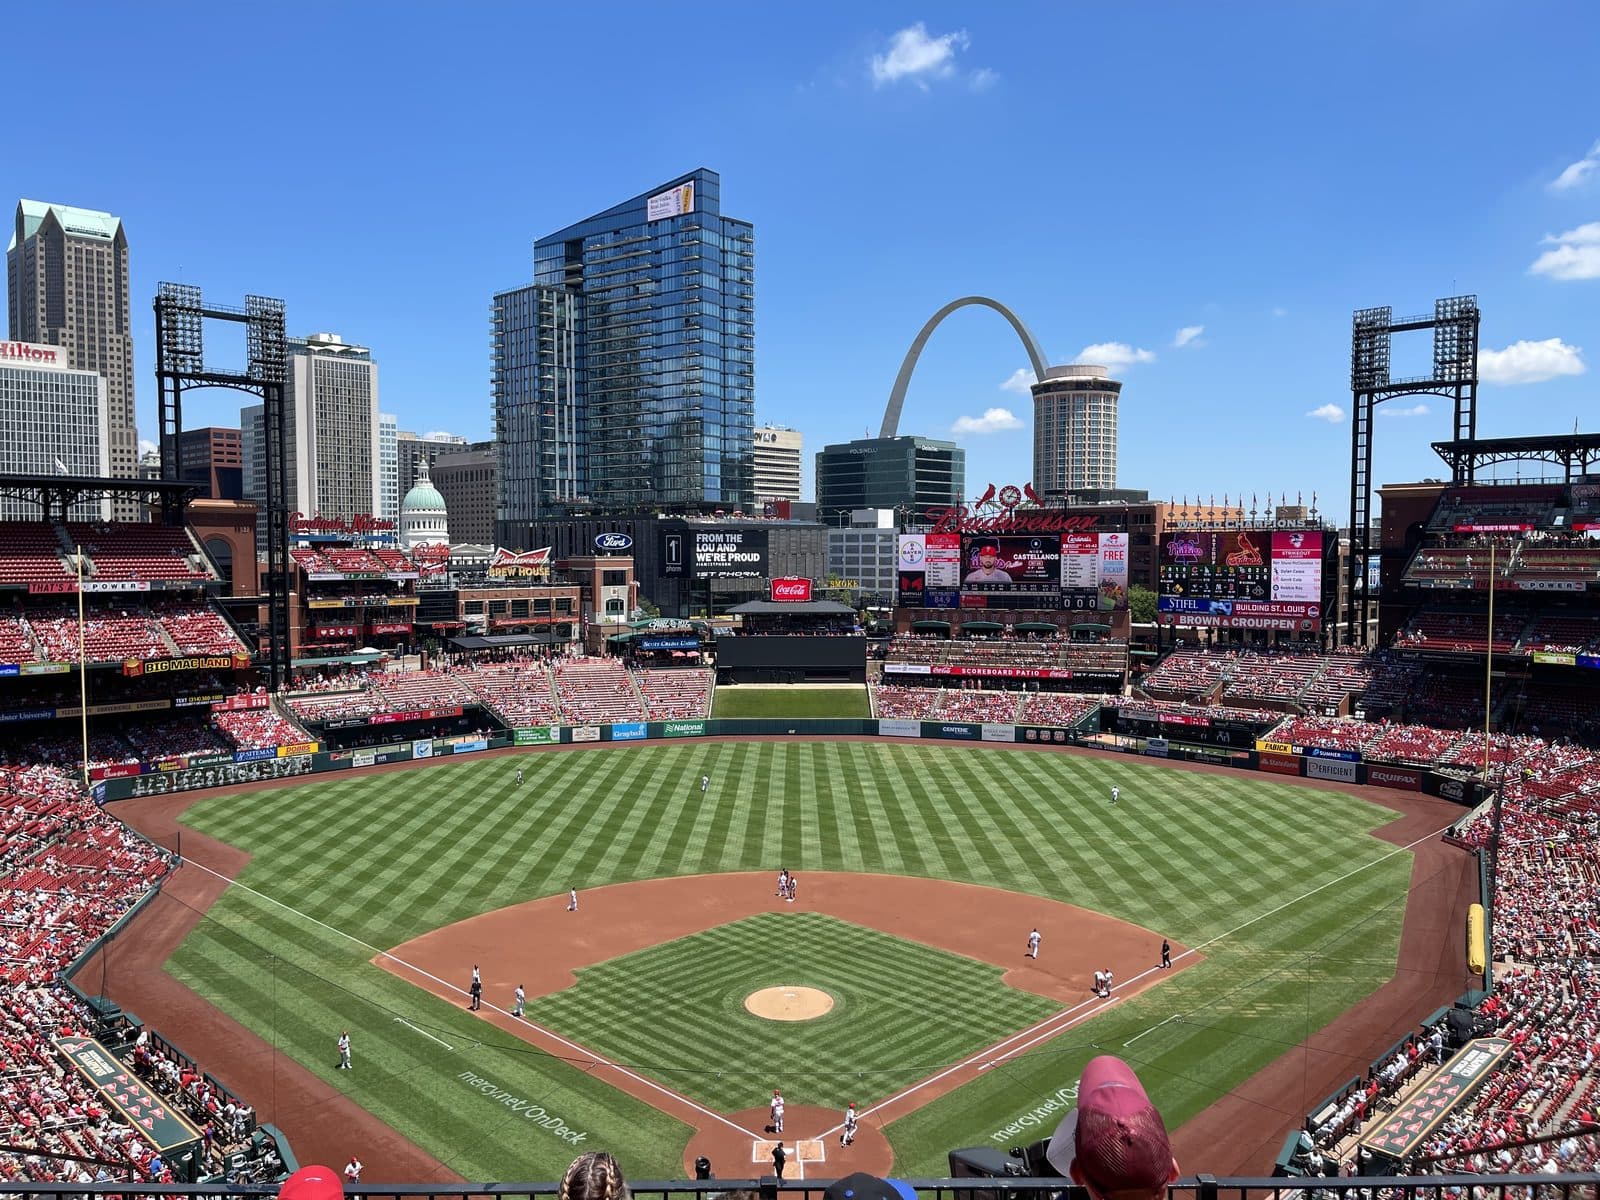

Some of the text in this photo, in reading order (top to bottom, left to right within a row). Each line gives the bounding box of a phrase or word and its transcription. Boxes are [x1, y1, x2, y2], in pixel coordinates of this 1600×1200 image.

[289, 512, 345, 533] Cardinals
[926, 506, 1100, 534] Budweiser
[1225, 520, 1306, 528] CHAMPIONS
[603, 536, 626, 546] Ford
[696, 534, 742, 542] FROM THE
[1068, 534, 1092, 544] Cardinals
[696, 544, 736, 552] LOU AND
[489, 554, 550, 566] Budweiser
[696, 552, 760, 562] WE'RE PROUD
[1104, 550, 1124, 560] FREE
[489, 567, 550, 576] BREW HOUSE
[32, 584, 73, 592] THAT'S A
[830, 580, 858, 588] SMOKE
[776, 584, 808, 595] Coca-Cola
[1064, 599, 1095, 608] 0 0 0
[1169, 599, 1198, 609] STIFEL
[1179, 616, 1220, 625] BROWN
[1232, 617, 1295, 629] CROUPPEN
[145, 657, 231, 674] BIG MAC LAND
[961, 668, 1013, 676] SCOREBOARD
[19, 710, 52, 720] University
[246, 748, 275, 756] SITEMAN
[286, 745, 311, 753] DOBBS
[1264, 743, 1303, 754] FABICK CAT
[1309, 762, 1352, 776] PERFICIENT
[1371, 771, 1416, 784] EQUIFAX
[458, 1070, 587, 1146] mercy.net/OnDeck
